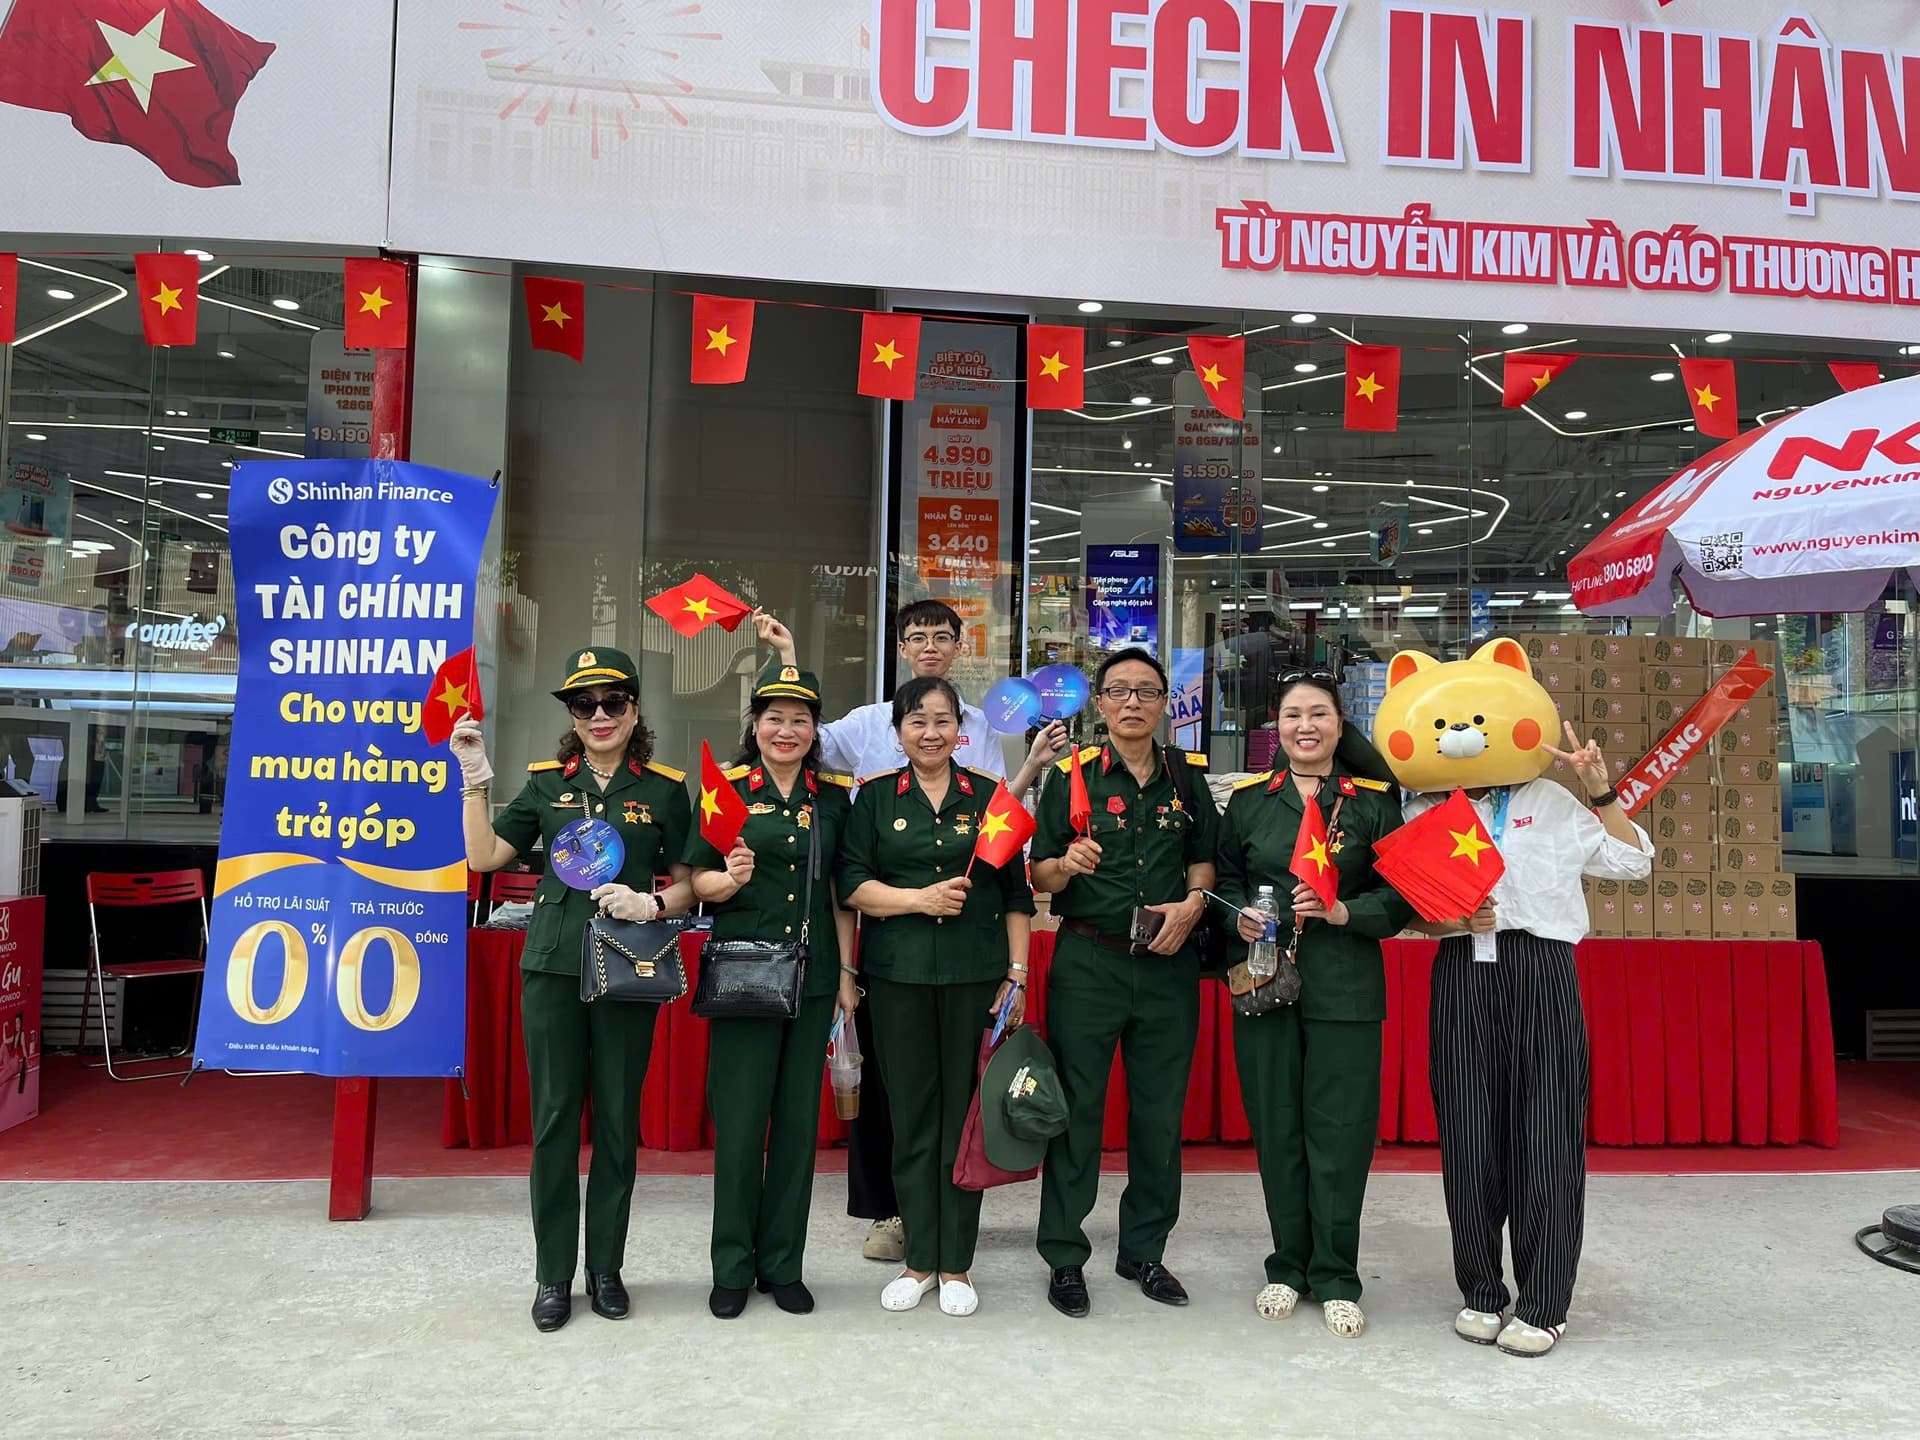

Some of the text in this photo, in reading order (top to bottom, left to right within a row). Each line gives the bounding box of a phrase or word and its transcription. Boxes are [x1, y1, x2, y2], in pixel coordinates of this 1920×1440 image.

[875, 0, 1920, 210] CHECK IN NHẬN
[1222, 208, 1281, 265] TỪ
[1290, 209, 1458, 273] NGUYỄN
[1472, 230, 1551, 278] KIM
[1565, 228, 1620, 282] VÀ
[1634, 229, 1716, 286] CÁC
[321, 368, 351, 384] ĐIỆN
[323, 384, 371, 397] IPHONE
[296, 482, 454, 503] Shinhan Finance
[926, 467, 993, 495] TRIỆU
[949, 504, 963, 521] 6
[279, 522, 436, 566] Công ty
[1109, 550, 1140, 558] ASUS
[254, 574, 463, 620] TÀI CHÍNH
[269, 638, 448, 675] SHINHAN
[279, 691, 422, 734] Cho vay
[250, 743, 448, 793] mua hàng
[1617, 723, 1703, 810] UÀ TẶNG
[275, 801, 416, 849] trả góp
[256, 895, 281, 911] TRỢ
[378, 899, 424, 916] TRƯỚC
[336, 926, 421, 1032] 0
